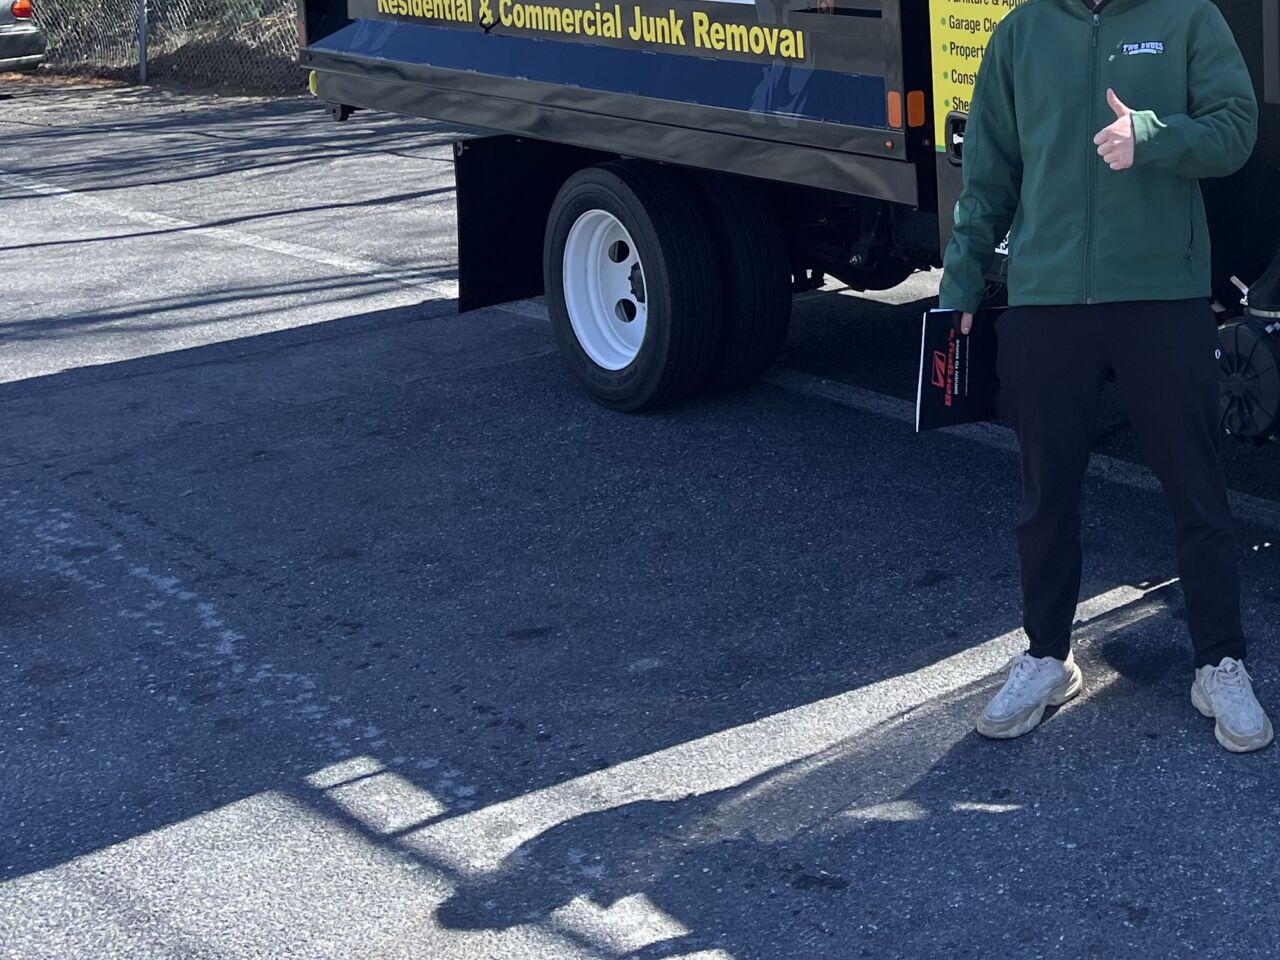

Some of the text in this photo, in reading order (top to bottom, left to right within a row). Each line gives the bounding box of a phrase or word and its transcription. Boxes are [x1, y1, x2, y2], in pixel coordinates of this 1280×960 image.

[628, 5, 686, 46] Junk
[692, 11, 805, 59] Removal
[948, 15, 980, 34] Garage
[954, 360, 960, 370] TO
